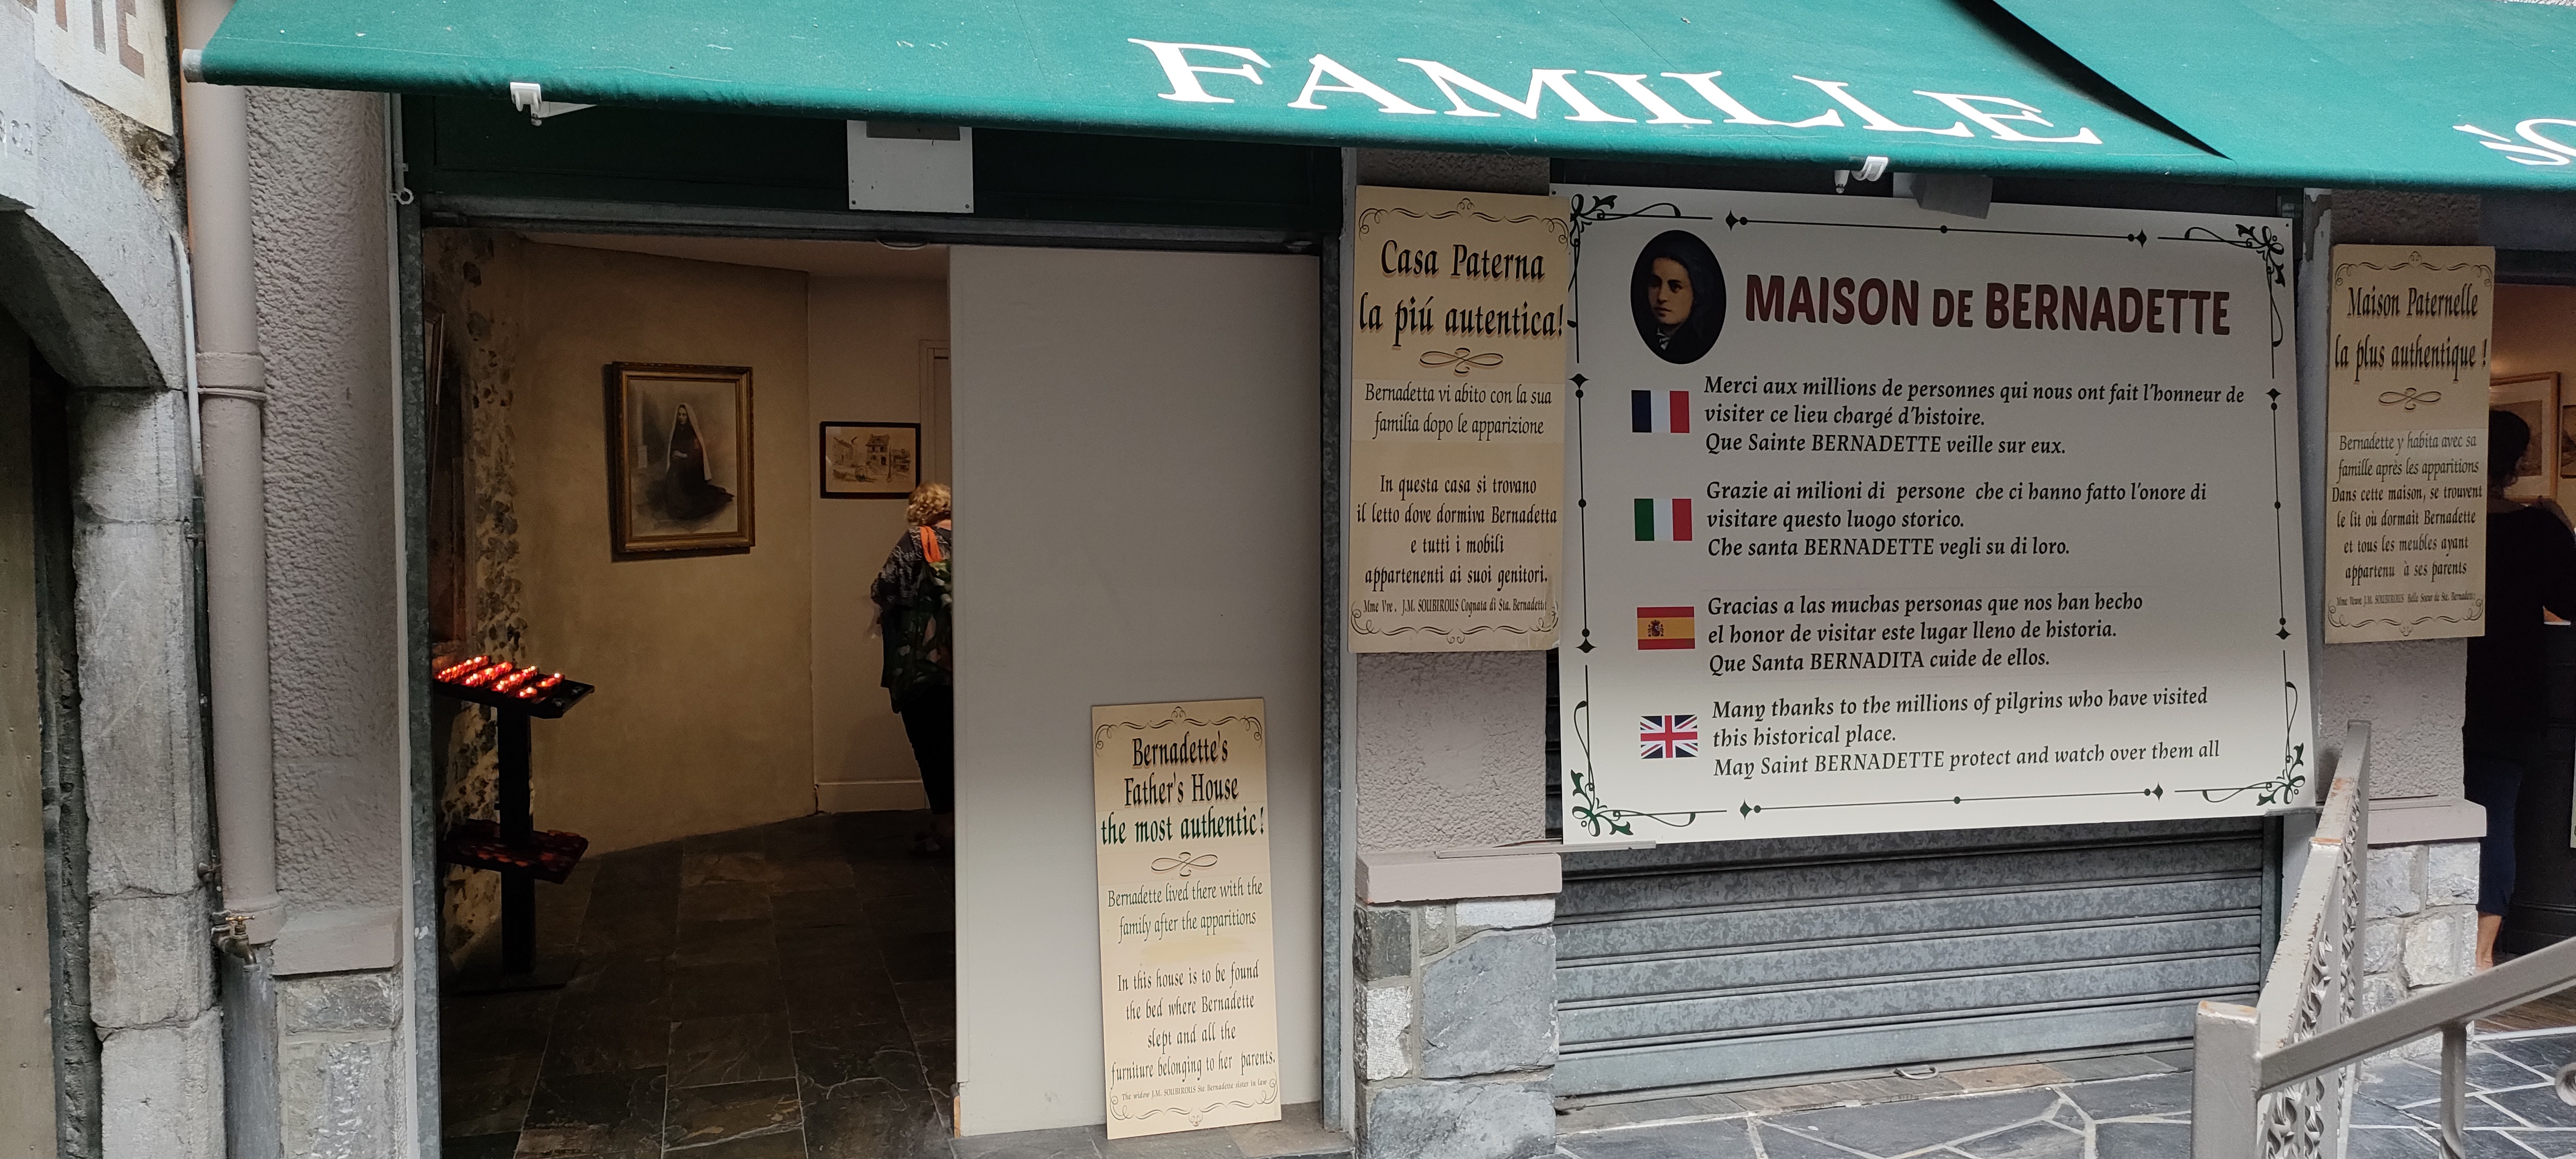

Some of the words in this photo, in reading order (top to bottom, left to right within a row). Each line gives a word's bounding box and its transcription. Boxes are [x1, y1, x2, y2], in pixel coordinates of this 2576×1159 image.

[1128, 38, 2102, 144] FAMILLE
[1382, 240, 1439, 277] Casa
[1451, 245, 1545, 283] Paterna
[1360, 292, 1383, 333] la
[1446, 301, 1564, 338] autentica!
[1746, 275, 1919, 325] MAISON
[1933, 289, 1973, 327] DE
[1986, 283, 2229, 335] BERNADETTE
[2347, 285, 2400, 319] Maison
[2407, 283, 2478, 318] Paternelle
[2335, 334, 2349, 368] la
[2354, 334, 2384, 384] plus
[2392, 334, 2476, 384] authentique
[1365, 381, 1435, 402] Bernadetta
[1438, 384, 1451, 402] vi
[1455, 383, 1486, 403] abito
[1491, 391, 1513, 403] con
[1517, 384, 1528, 403] la
[1531, 392, 1552, 404] sua
[1705, 403, 1764, 422] visiter
[1770, 410, 1788, 422] ce
[1794, 405, 1828, 423] lieu
[1834, 406, 1892, 428] chargé
[1899, 406, 1984, 425] d'histoire.
[1706, 433, 1741, 454] Que
[1749, 432, 1805, 451] Sainte
[1811, 435, 1941, 452] BERNADETTE
[1946, 435, 1993, 453] veille
[1998, 441, 2026, 453] sur
[2031, 441, 2065, 454] eux.
[2339, 432, 2394, 450] Bernadette
[2396, 438, 2404, 456] y
[2407, 431, 2439, 449] habita
[2442, 436, 2463, 447] avec
[2466, 436, 2477, 447] sa
[1380, 475, 1393, 492] In
[1399, 478, 1438, 501] questa
[1445, 480, 1471, 493] casa
[1477, 475, 1487, 493] si
[1492, 479, 1536, 494] trovano
[2331, 488, 2357, 501] Dans
[2361, 488, 2383, 501] cette
[2388, 485, 2426, 503] maison,
[2430, 488, 2438, 499] se
[2443, 485, 2481, 499] trouvent
[1707, 509, 1777, 527] visitare
[1783, 512, 1841, 532] questo
[1847, 509, 1896, 532] luogo
[1902, 509, 1963, 527] storico.
[1709, 537, 1742, 556] Che
[1748, 540, 1798, 556] santa
[1804, 538, 1934, 555] BERNADETTE
[1939, 537, 1980, 559] vegli
[1986, 542, 2005, 554] su
[2011, 537, 2027, 554] di
[2032, 537, 2069, 554] loro.
[1365, 565, 1444, 592] appartenenti
[1450, 565, 1462, 583] ai
[1467, 565, 1492, 583] suoi
[1497, 564, 1547, 591] genitori.
[2345, 564, 2396, 586] appartenu
[2404, 561, 2409, 576] à
[2414, 564, 2427, 576] ses
[2431, 561, 2467, 582] parents
[1363, 600, 1378, 612] Mme
[1401, 600, 1415, 616] J.M.
[1418, 599, 1458, 612] SOUBIROUS
[1461, 598, 1487, 617] Cognata
[1490, 597, 1496, 611] di
[1499, 598, 1511, 611] Sta.
[1708, 596, 1778, 615] Gracias
[1784, 601, 1794, 613] a
[1800, 595, 1825, 613] las
[1831, 595, 1899, 613] muchas
[1904, 599, 1982, 616] personas
[1988, 598, 2018, 616] que
[2024, 598, 2052, 610] nos
[2057, 592, 2089, 610] han
[2095, 592, 2143, 610] hecho
[1710, 655, 1745, 676] Que
[1752, 654, 1804, 671] Santa
[1810, 651, 1925, 670] BERNADITA
[1930, 649, 1976, 667] cuide
[1982, 648, 2002, 666] de
[2008, 647, 2049, 665] ellos.
[1132, 730, 1228, 766] Bernadette's
[1713, 728, 1746, 747] this
[1754, 725, 1840, 746] historical
[1845, 724, 1895, 747] place.
[1714, 759, 1754, 780] May
[1761, 755, 1808, 774] Saint
[1814, 751, 1944, 772] BERNADETTE
[1949, 750, 2011, 771] protect
[2017, 746, 2049, 764] and
[2055, 744, 2104, 763] watch
[2110, 748, 2146, 761] over
[2151, 742, 2193, 759] them
[2199, 739, 2219, 757] all
[1124, 772, 1183, 806] Father's
[1191, 773, 1239, 801] House
[1101, 812, 1126, 845] the
[1135, 816, 1173, 843] most
[1181, 806, 1263, 840] authentic!
[1108, 885, 1162, 907] Bernadette
[1166, 881, 1189, 902] lived
[1192, 880, 1217, 900] there
[1219, 877, 1244, 897] with
[1247, 876, 1263, 895] the
[1118, 914, 1150, 944] family
[1155, 913, 1178, 940] after
[1182, 910, 1197, 930] the
[1201, 909, 1256, 936] apparitions
[1118, 975, 1128, 991] In
[1134, 970, 1151, 990] this
[1157, 968, 1184, 987] house
[1189, 967, 1197, 985] is
[1202, 970, 1211, 983] to
[1216, 963, 1226, 982] be
[1230, 959, 1259, 988] found
[1148, 1028, 1172, 1054] slept
[1177, 1024, 1197, 1044] and
[1202, 1022, 1216, 1042] all
[1221, 1021, 1236, 1040] the
[1111, 1061, 1154, 1090] furniture
[1158, 1055, 1201, 1082] belonging
[1207, 1057, 1214, 1071] to
[1219, 1051, 1232, 1070] her
[1241, 1051, 1275, 1075] parents.
[1133, 1090, 1149, 1099] widow
[1151, 1090, 1160, 1099] J.M.
[1163, 1086, 1196, 1096] SOUBIROUS
[1207, 1082, 1233, 1091] Bernadette
